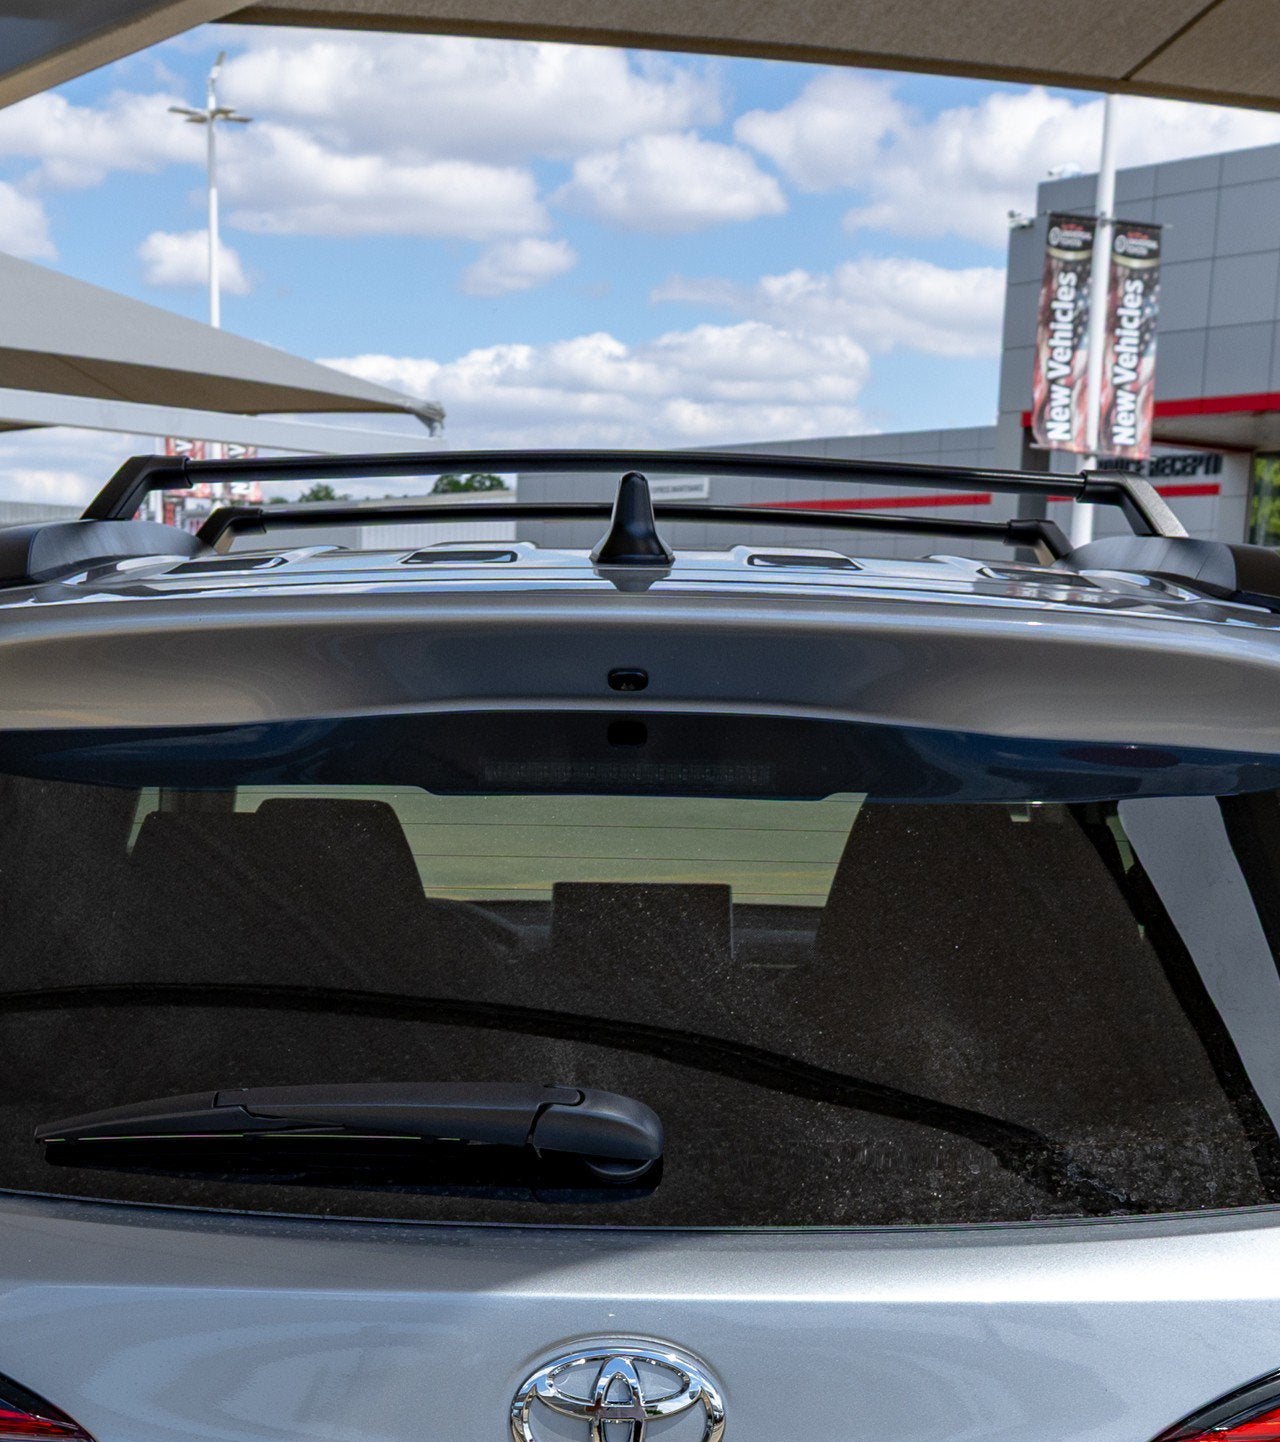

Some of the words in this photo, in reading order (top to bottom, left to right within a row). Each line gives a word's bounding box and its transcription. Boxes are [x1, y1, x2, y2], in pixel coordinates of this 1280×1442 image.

[1047, 271, 1078, 380] Vehicles
[1113, 278, 1145, 384] Vehicles
[1046, 387, 1071, 440] New
[1113, 392, 1137, 446] New
